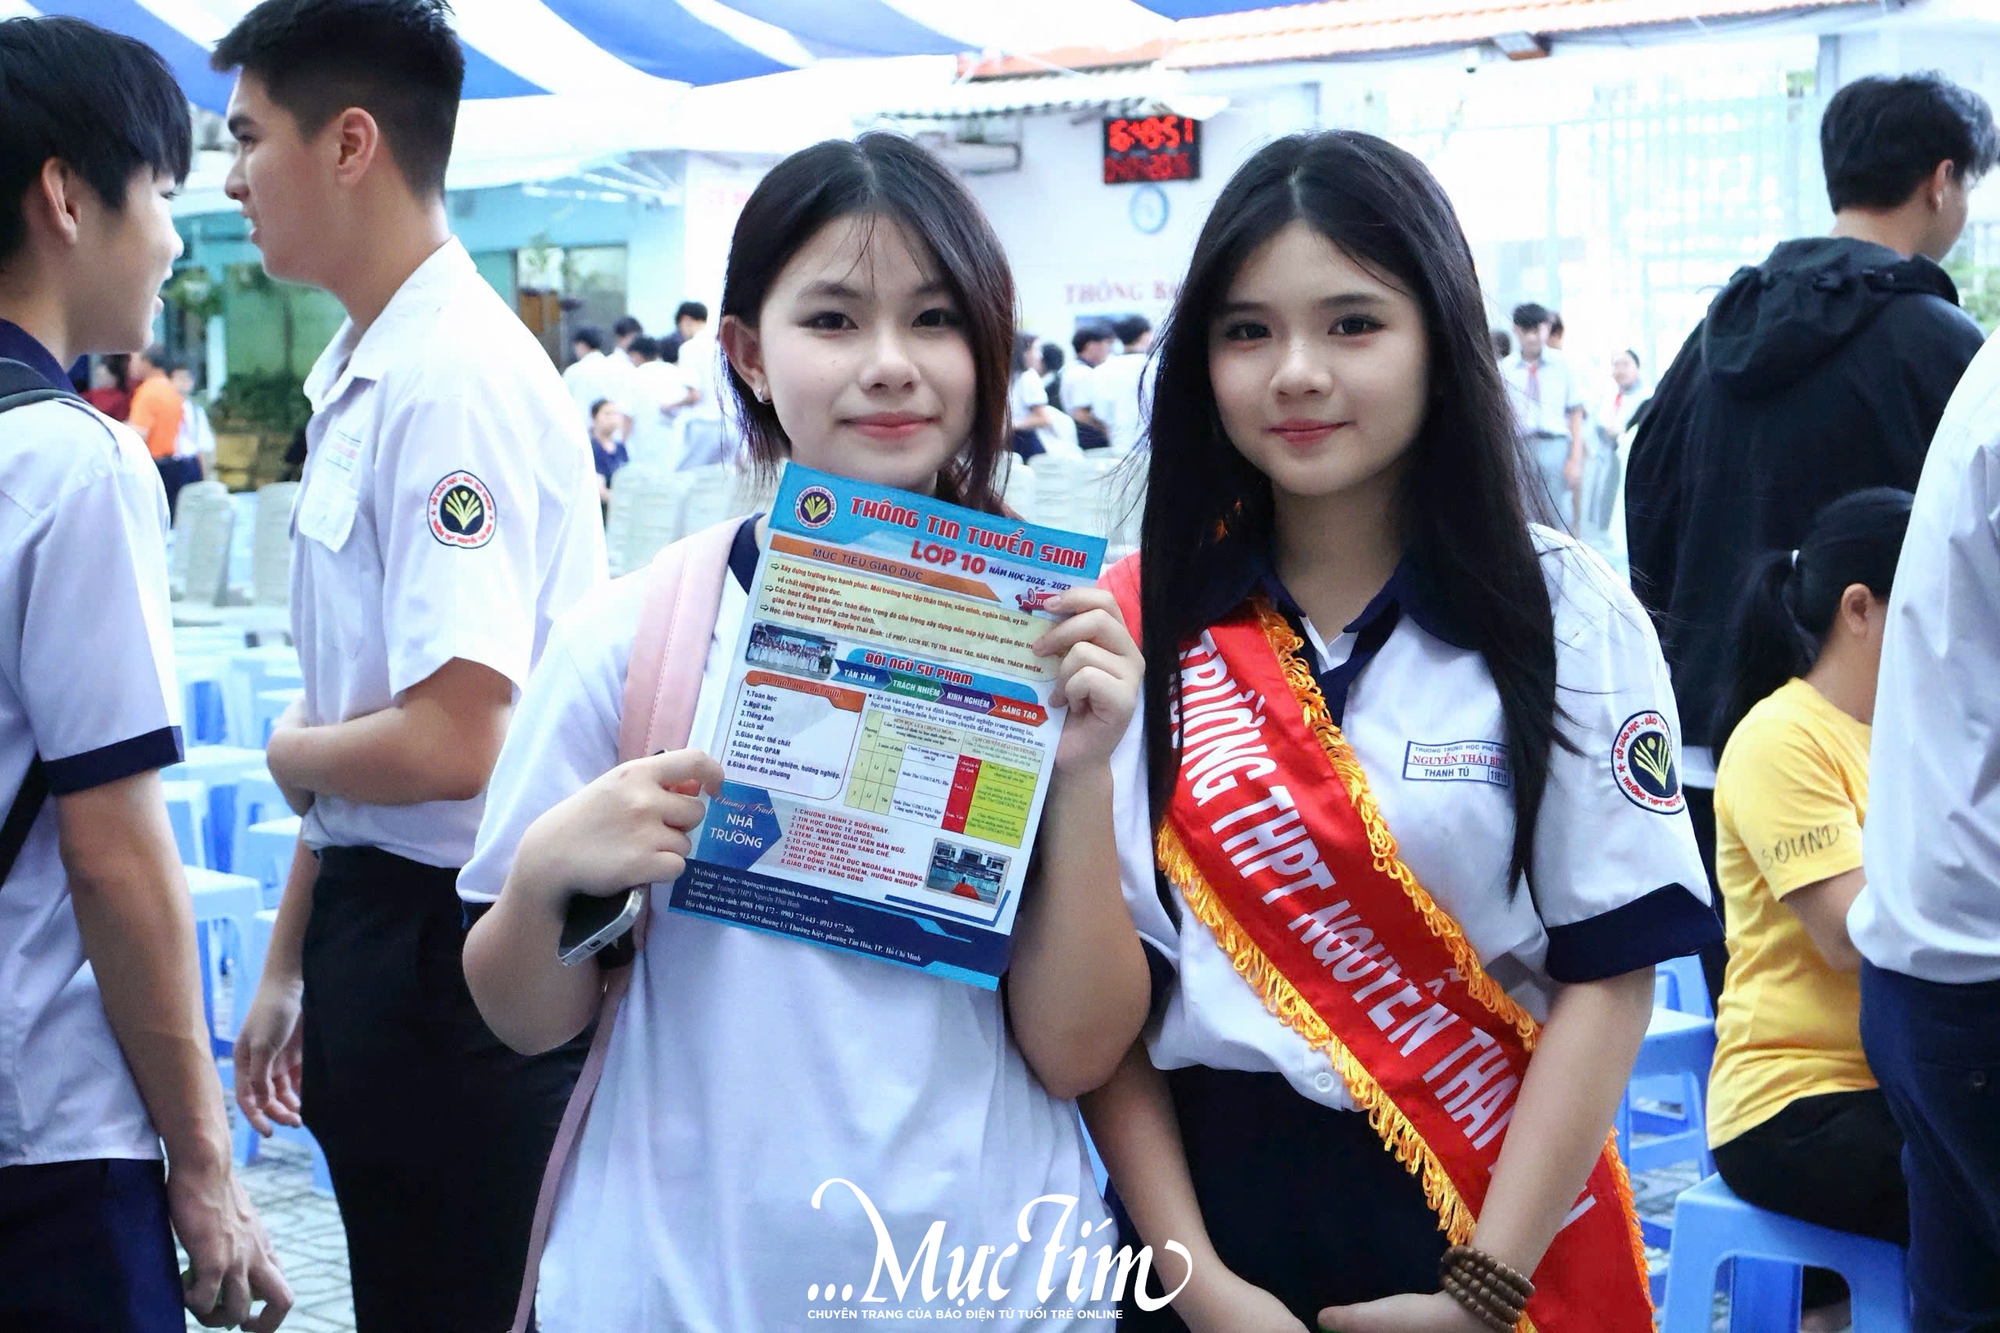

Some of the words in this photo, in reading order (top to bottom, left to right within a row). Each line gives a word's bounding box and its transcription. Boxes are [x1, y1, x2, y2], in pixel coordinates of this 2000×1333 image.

[848, 491, 921, 529] THÔNG
[924, 513, 962, 539] TIN
[966, 526, 1038, 555] TUYỂN
[1038, 541, 1088, 570] SINH
[958, 552, 987, 575] 10
[1007, 570, 1025, 582] HỌC
[1025, 574, 1046, 586] 2026
[1050, 580, 1071, 592] 2027
[815, 615, 831, 625] THPT
[863, 648, 888, 669] ĐỘI
[887, 653, 915, 673] NGŨ
[915, 661, 936, 678] SƯ
[934, 667, 973, 689] PHẠM
[1168, 628, 1279, 807] TRƯỜNG
[1413, 752, 1458, 765] NGUYỄN
[1461, 753, 1487, 764] THÁI
[1424, 768, 1454, 777] THANH
[1458, 766, 1469, 777] TÚ
[708, 823, 764, 850] TRƯỜNG
[725, 809, 755, 829] NHÀ
[1211, 785, 1336, 905] THPT
[1761, 824, 1840, 870] SOUND
[1287, 899, 1464, 1058] NGUYỄN
